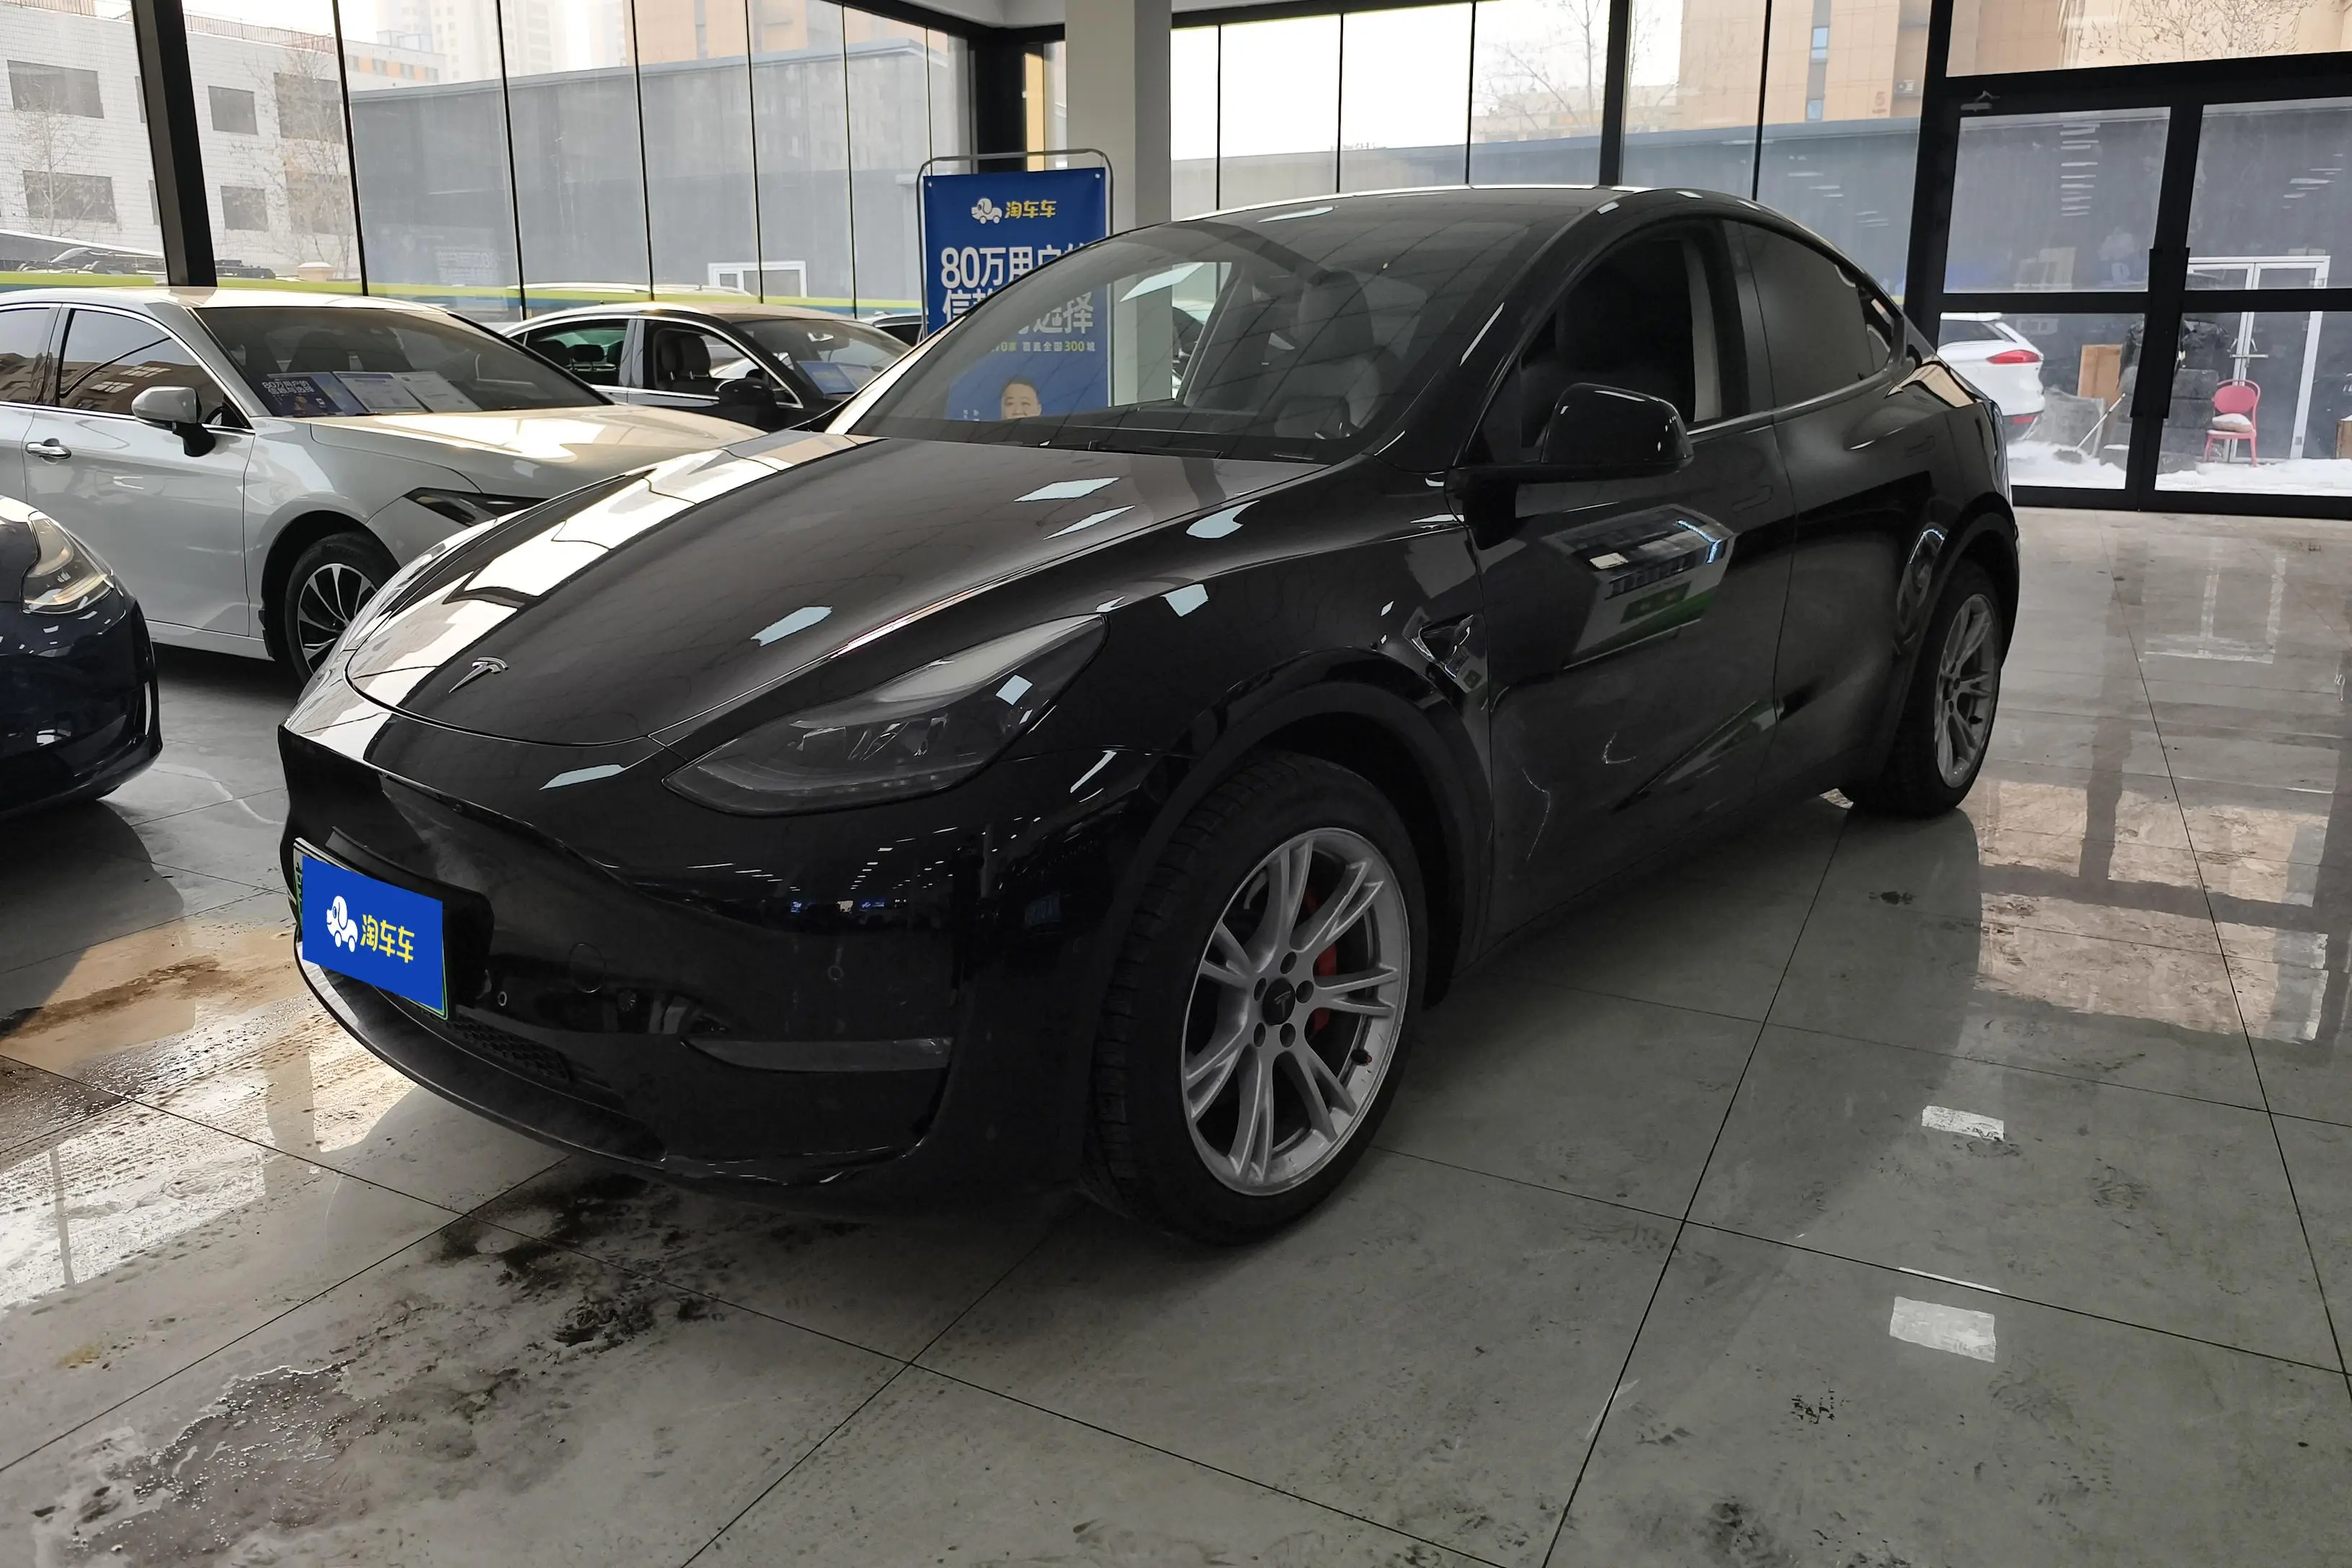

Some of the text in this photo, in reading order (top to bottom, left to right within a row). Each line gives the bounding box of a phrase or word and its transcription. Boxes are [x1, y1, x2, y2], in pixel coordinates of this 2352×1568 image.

[1004, 199, 1057, 218] 淘车车
[941, 242, 1084, 288] 80万用
